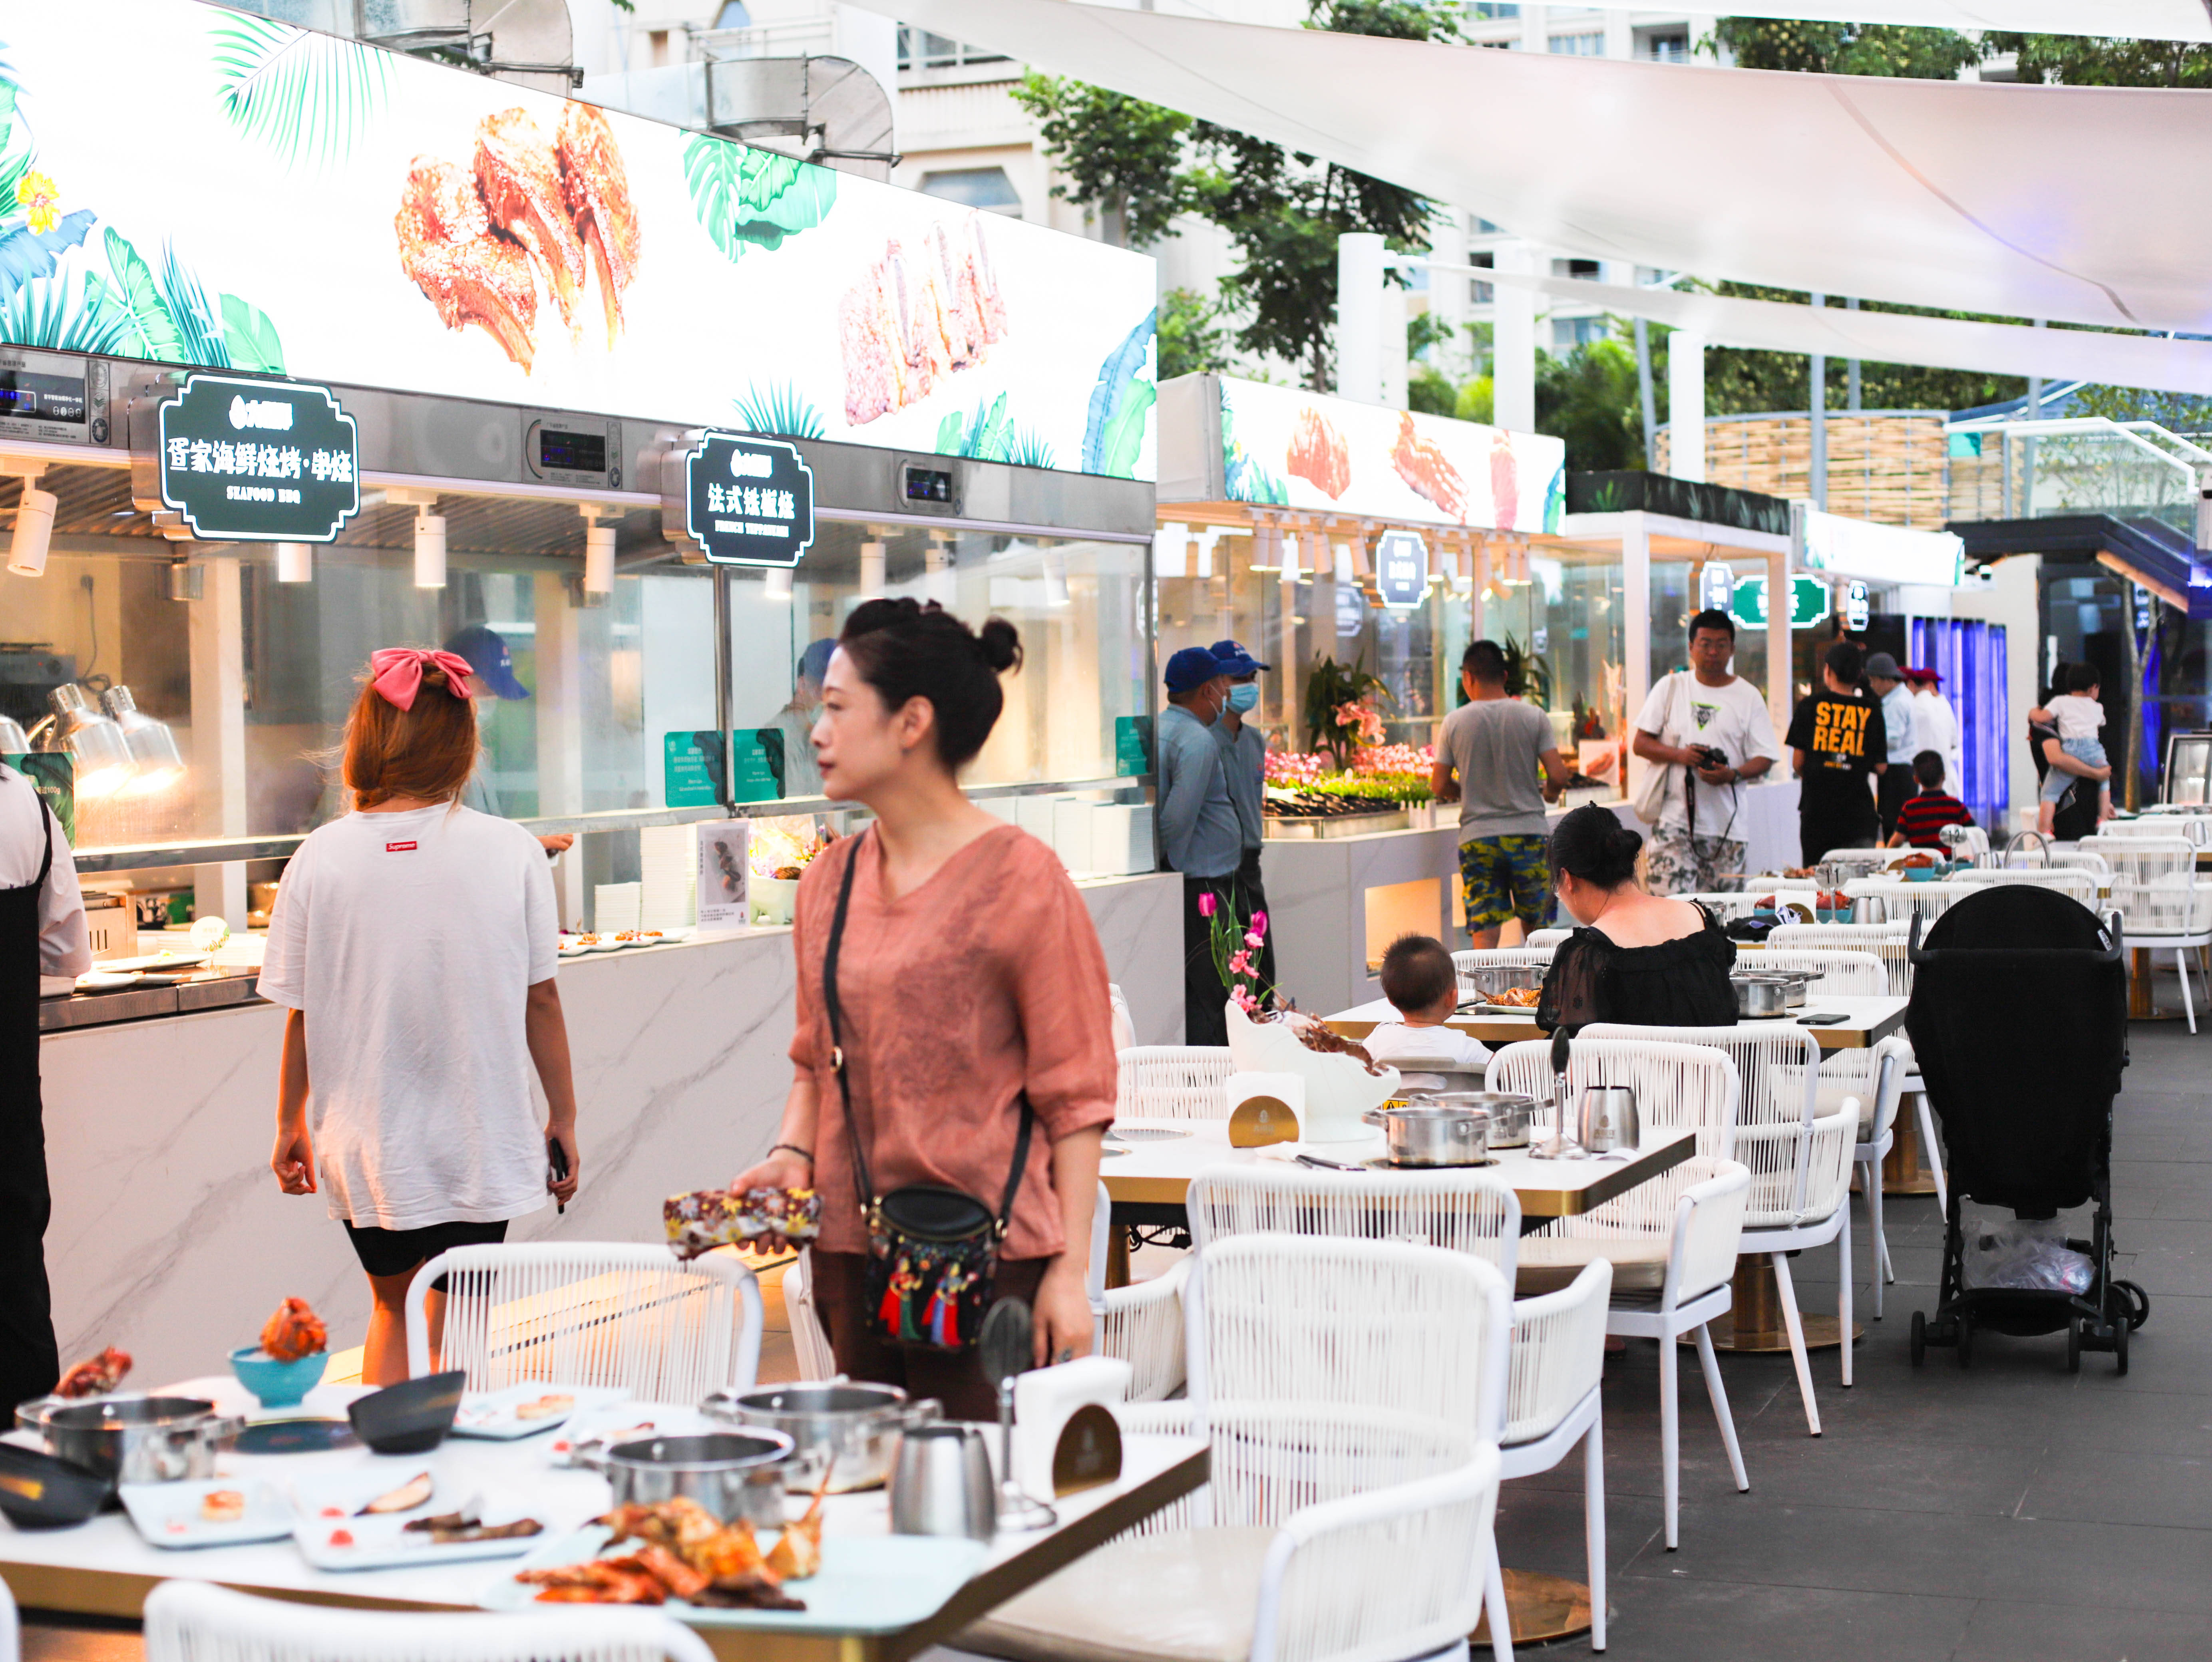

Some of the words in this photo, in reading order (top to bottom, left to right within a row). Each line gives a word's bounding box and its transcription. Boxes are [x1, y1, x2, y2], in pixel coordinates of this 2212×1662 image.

[227, 485, 275, 502] SEAFOOD
[278, 489, 300, 504] BBQ
[708, 483, 795, 519] 法式铁板烧
[1816, 701, 1871, 730] STAY
[1813, 725, 1865, 756] REAL
[1949, 829, 1960, 843] 12
[1826, 868, 1839, 884] 11
